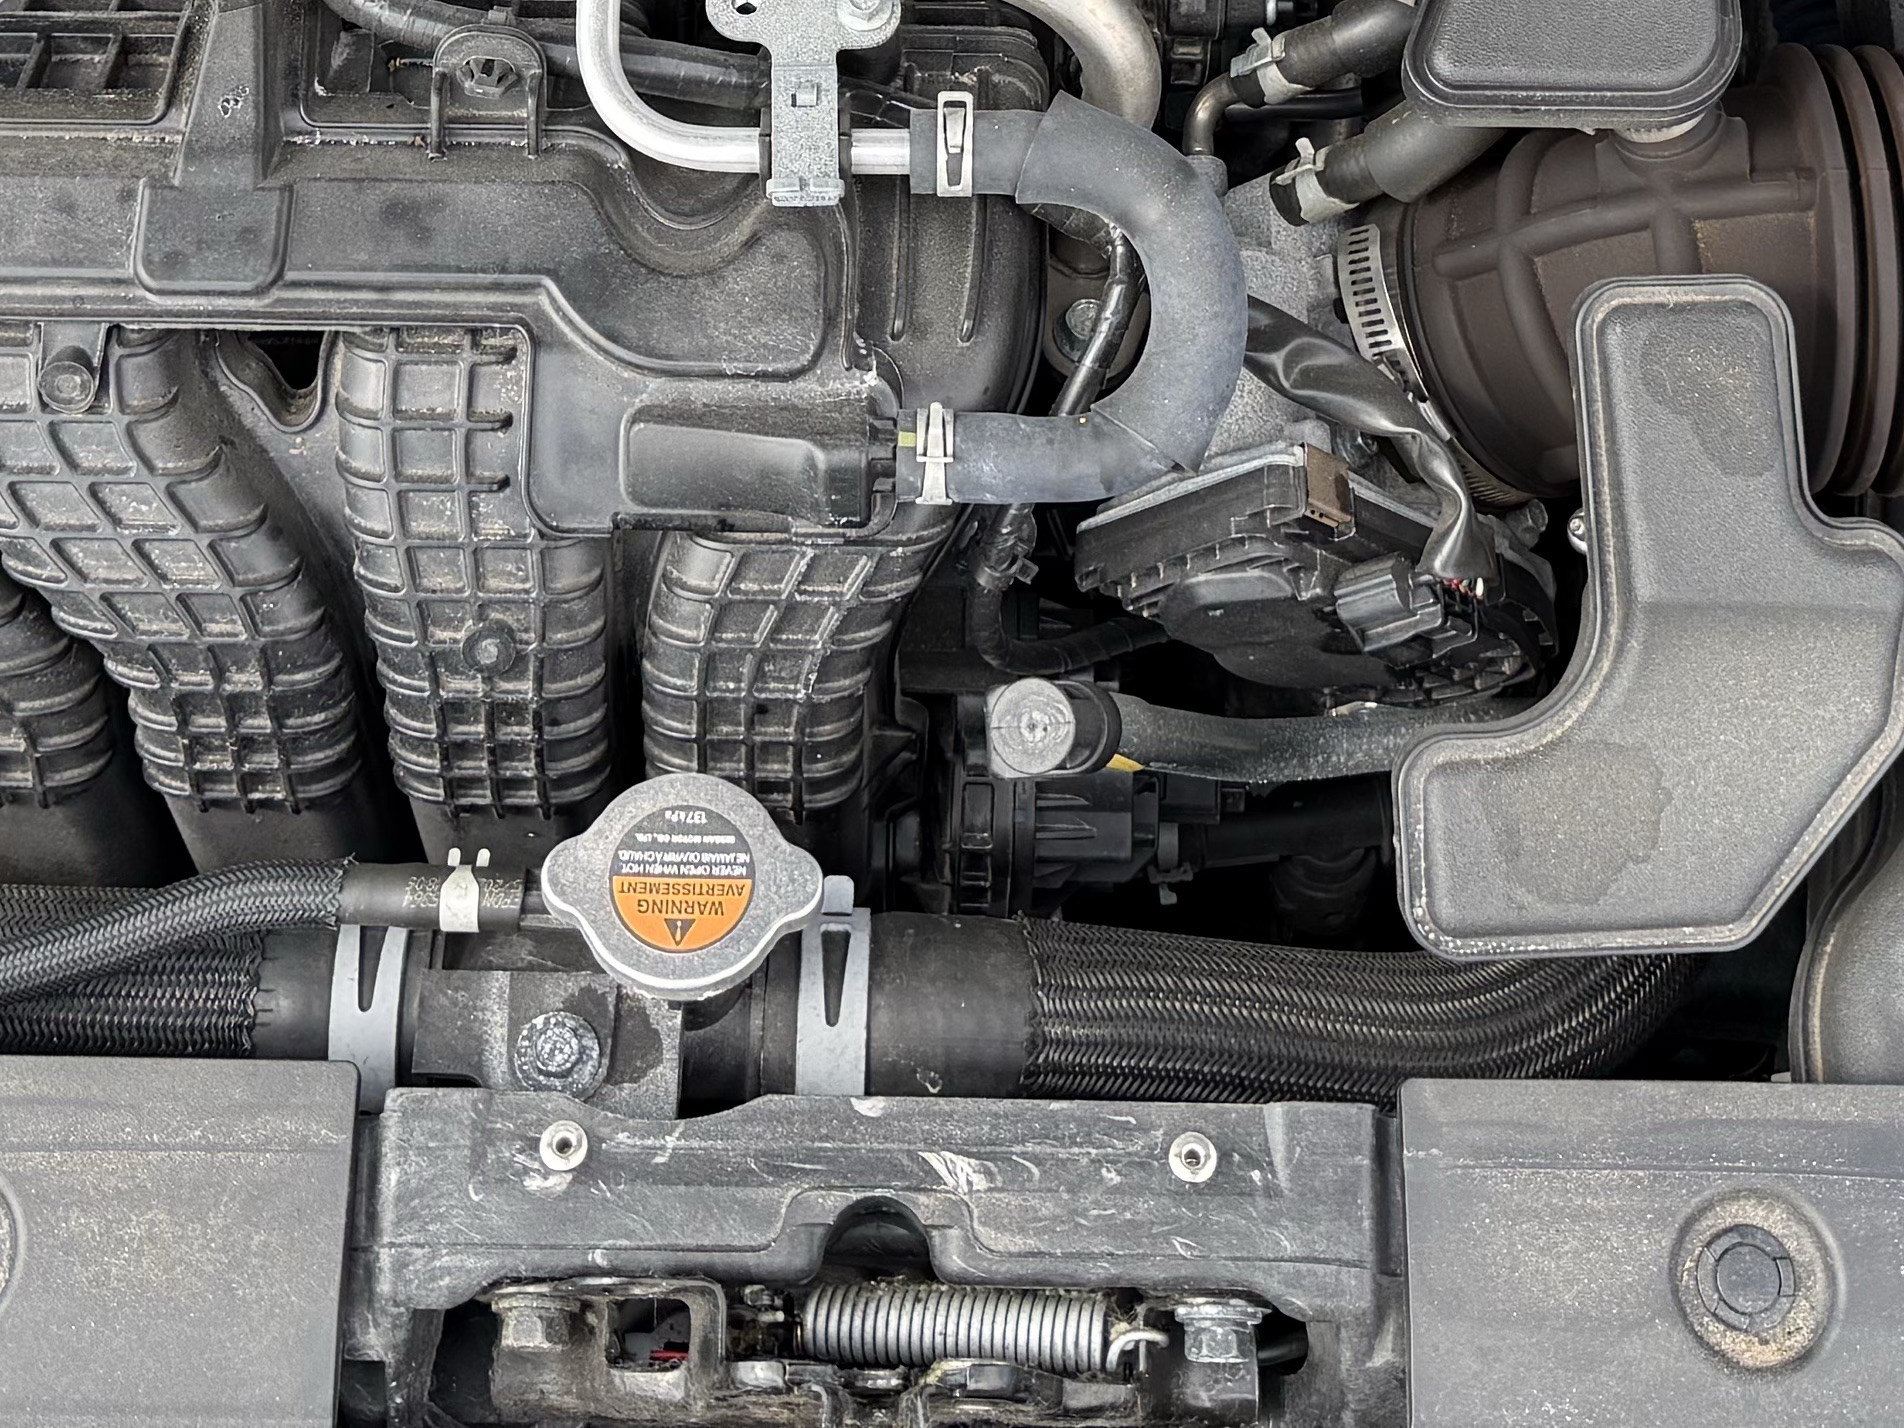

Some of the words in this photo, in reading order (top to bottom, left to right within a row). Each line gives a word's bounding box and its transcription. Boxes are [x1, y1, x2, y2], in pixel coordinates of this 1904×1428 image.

[688, 810, 708, 824] 137
[672, 834, 701, 843] MOTOR
[663, 851, 700, 863] OUVRIR
[701, 852, 735, 863] JAMAIS
[736, 852, 750, 863] NE
[646, 864, 678, 875] WHEN
[680, 864, 710, 875] OPEN
[711, 865, 746, 875] NEVER
[618, 881, 745, 896] AVERTISSEMENT
[637, 899, 724, 916] WARNING
